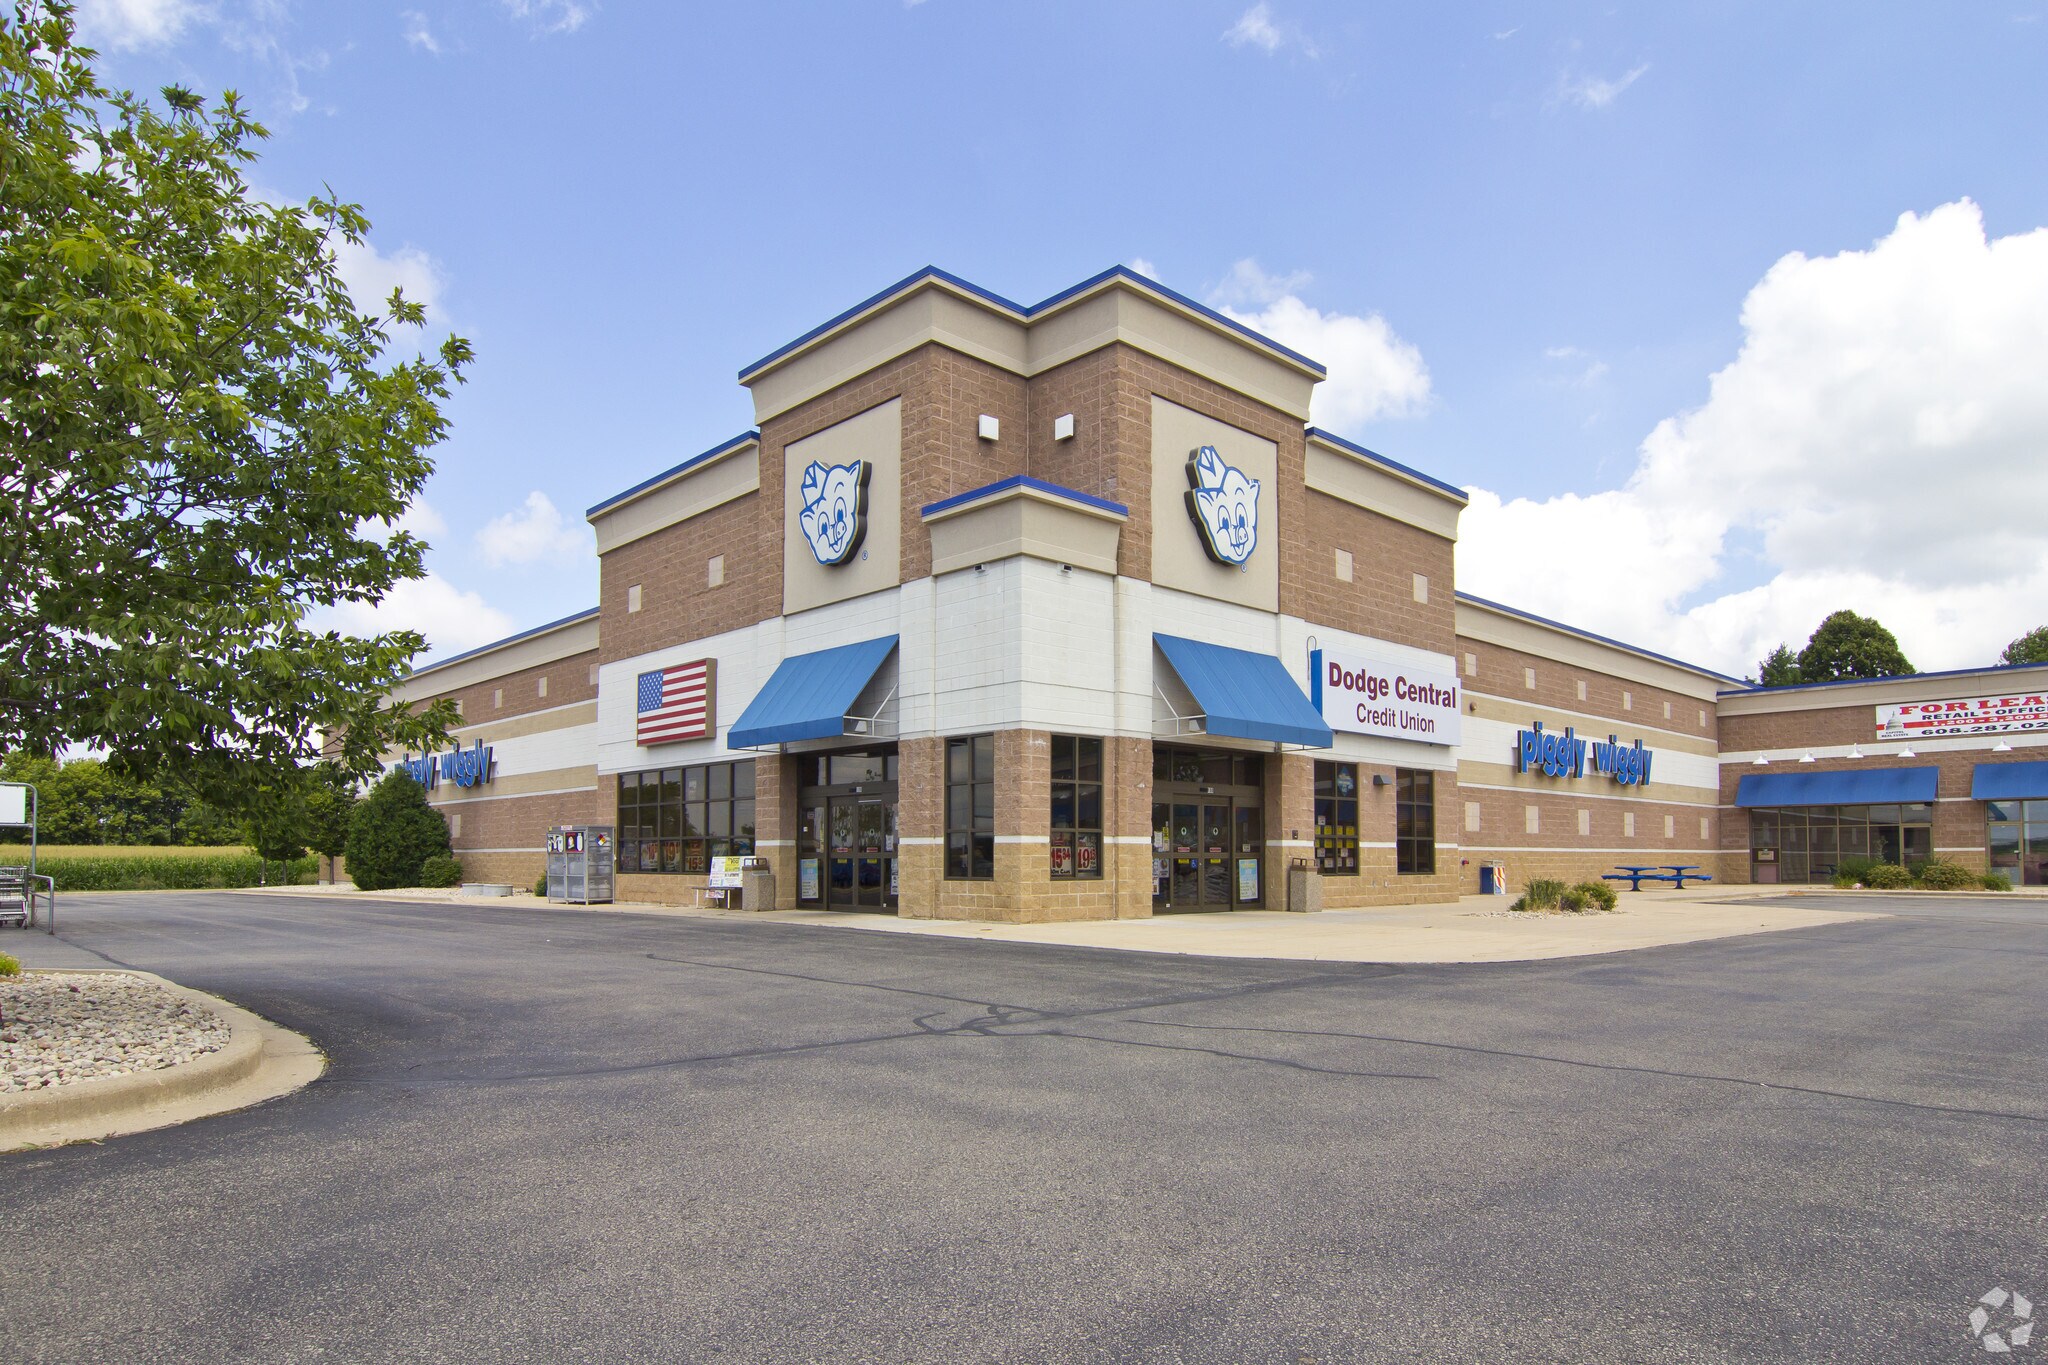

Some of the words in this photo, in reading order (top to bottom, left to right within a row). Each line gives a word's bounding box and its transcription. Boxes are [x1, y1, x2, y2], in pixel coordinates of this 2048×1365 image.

[1329, 662, 1389, 701] Dodge
[1395, 676, 1456, 709] Central
[1900, 702, 1969, 715] FOR
[1978, 695, 2048, 710] LEA
[1356, 703, 1396, 728] Credit
[1400, 711, 1435, 734] Union
[1922, 712, 1979, 720] RETAIL
[1995, 706, 2048, 715] OFFIC
[441, 738, 493, 788] wiggly
[1518, 721, 1586, 779] piggly
[1592, 735, 1653, 785] wiggly
